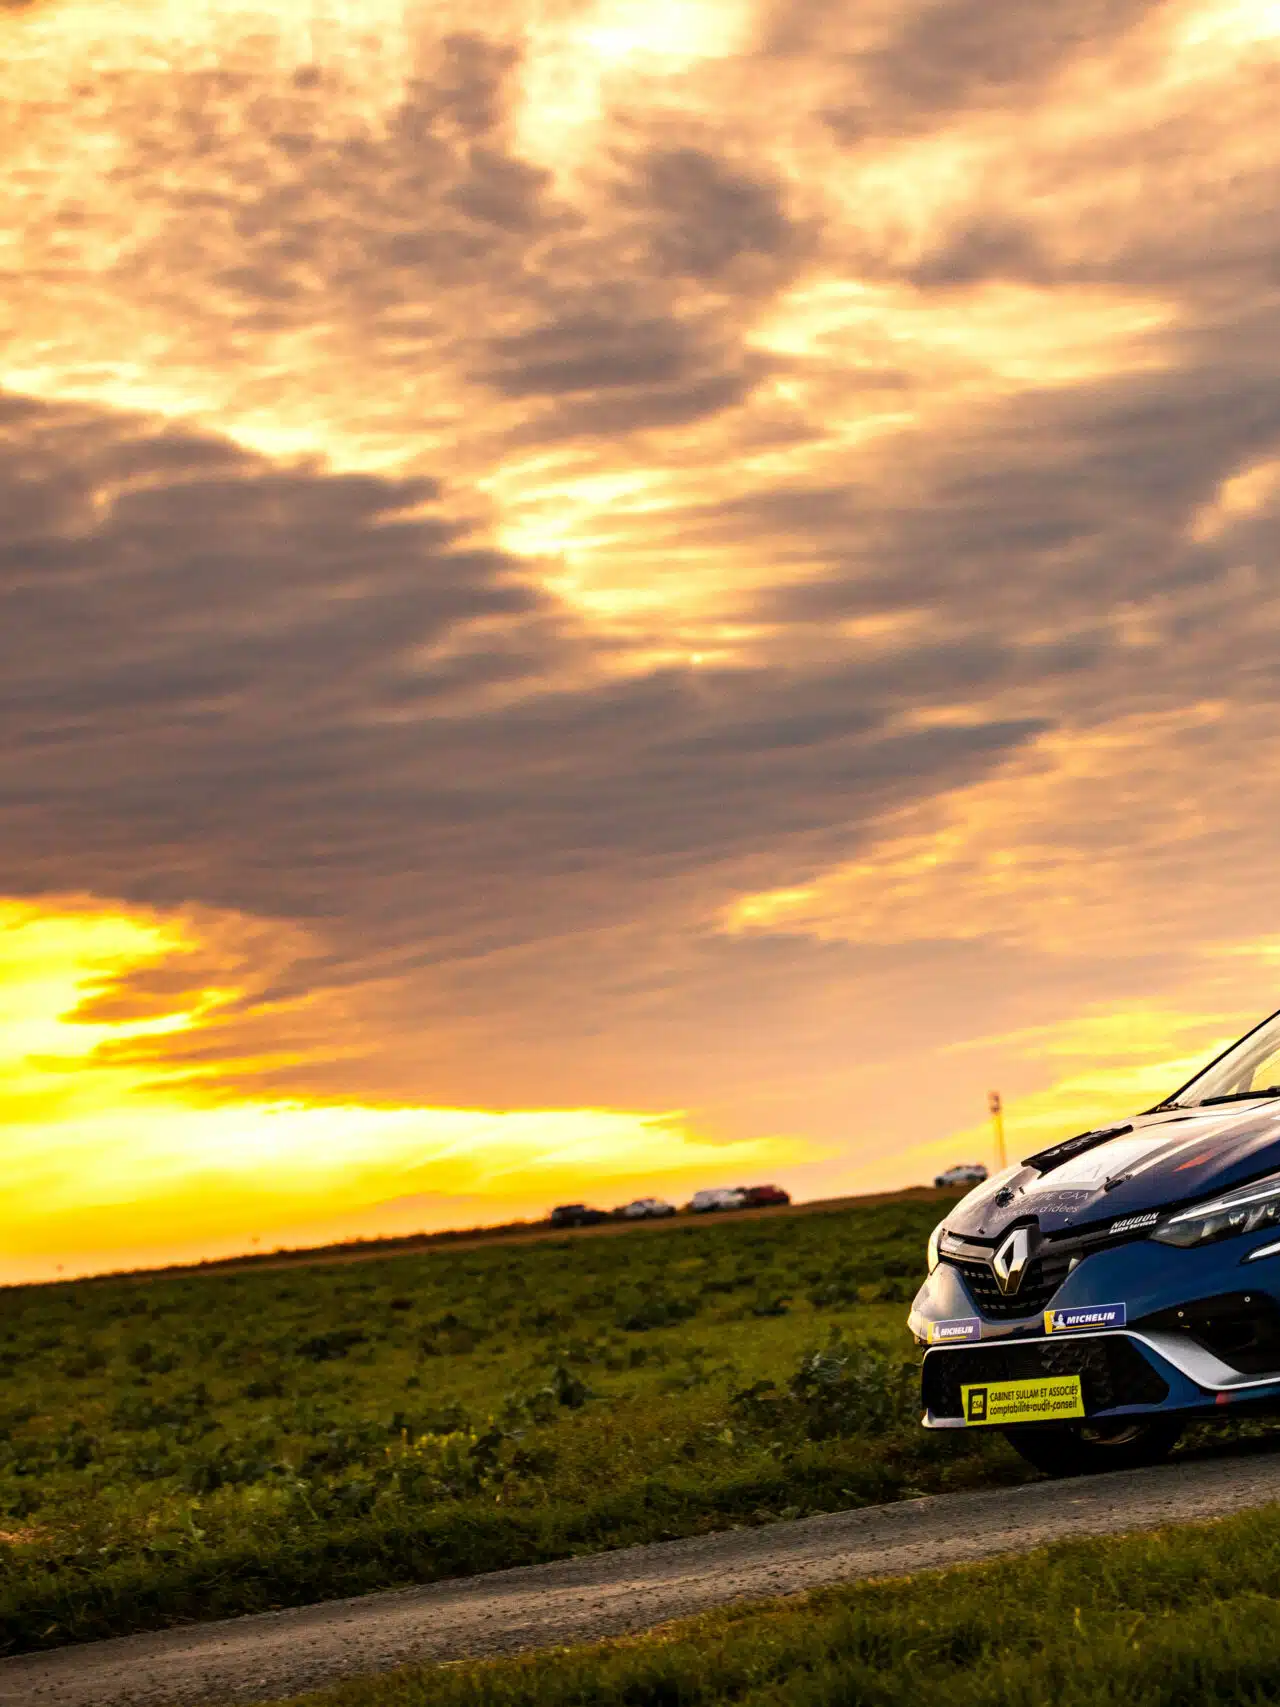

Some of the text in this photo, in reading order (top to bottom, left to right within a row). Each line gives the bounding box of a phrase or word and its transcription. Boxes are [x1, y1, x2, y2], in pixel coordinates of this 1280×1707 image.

[1111, 1211, 1160, 1229] NAUDON
[1066, 1312, 1116, 1325] MICHELIN
[941, 1325, 974, 1336] MICHELIN
[990, 1391, 1015, 1402] CABINET
[1016, 1389, 1039, 1400] SULLAM
[1040, 1387, 1048, 1398] ET
